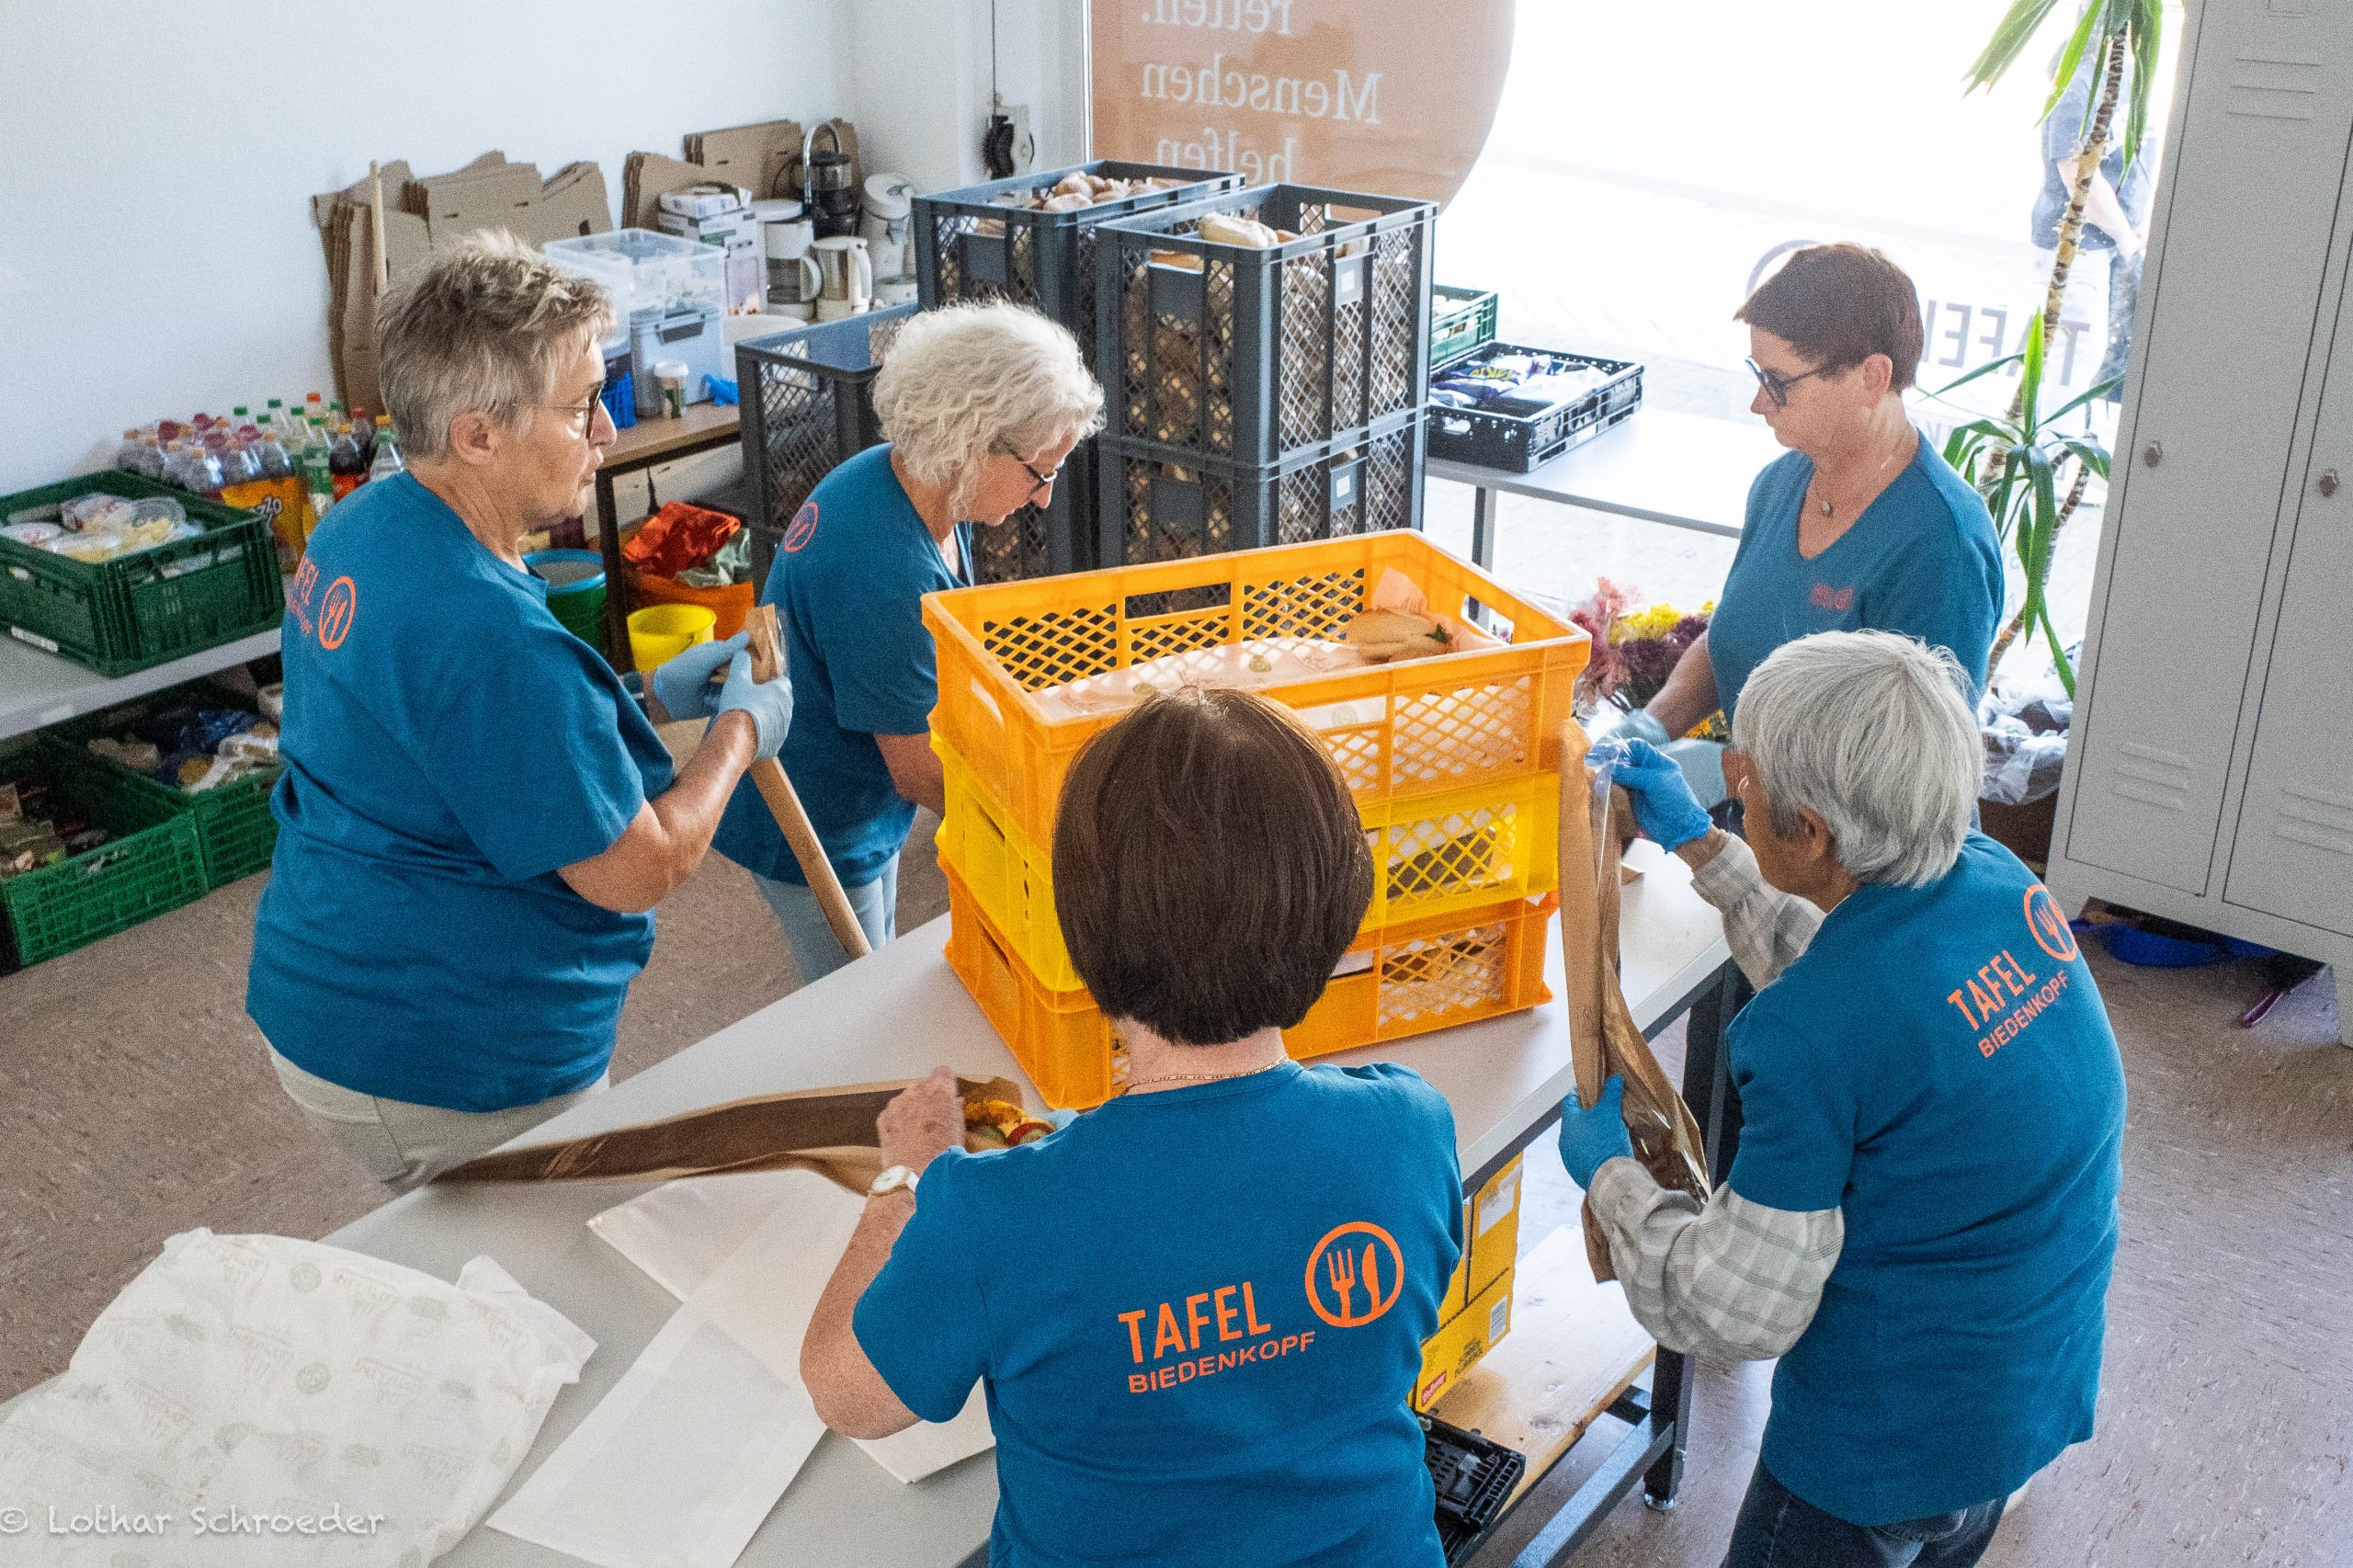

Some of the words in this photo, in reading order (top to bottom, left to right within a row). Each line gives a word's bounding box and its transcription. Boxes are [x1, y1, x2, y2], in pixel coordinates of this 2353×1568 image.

[1946, 949, 2036, 1030] TAFEL
[1977, 970, 2069, 1059] BIEDENKOPF
[1117, 1280, 1271, 1364] TAFEL
[1127, 1331, 1316, 1394] BIEDENKOPF
